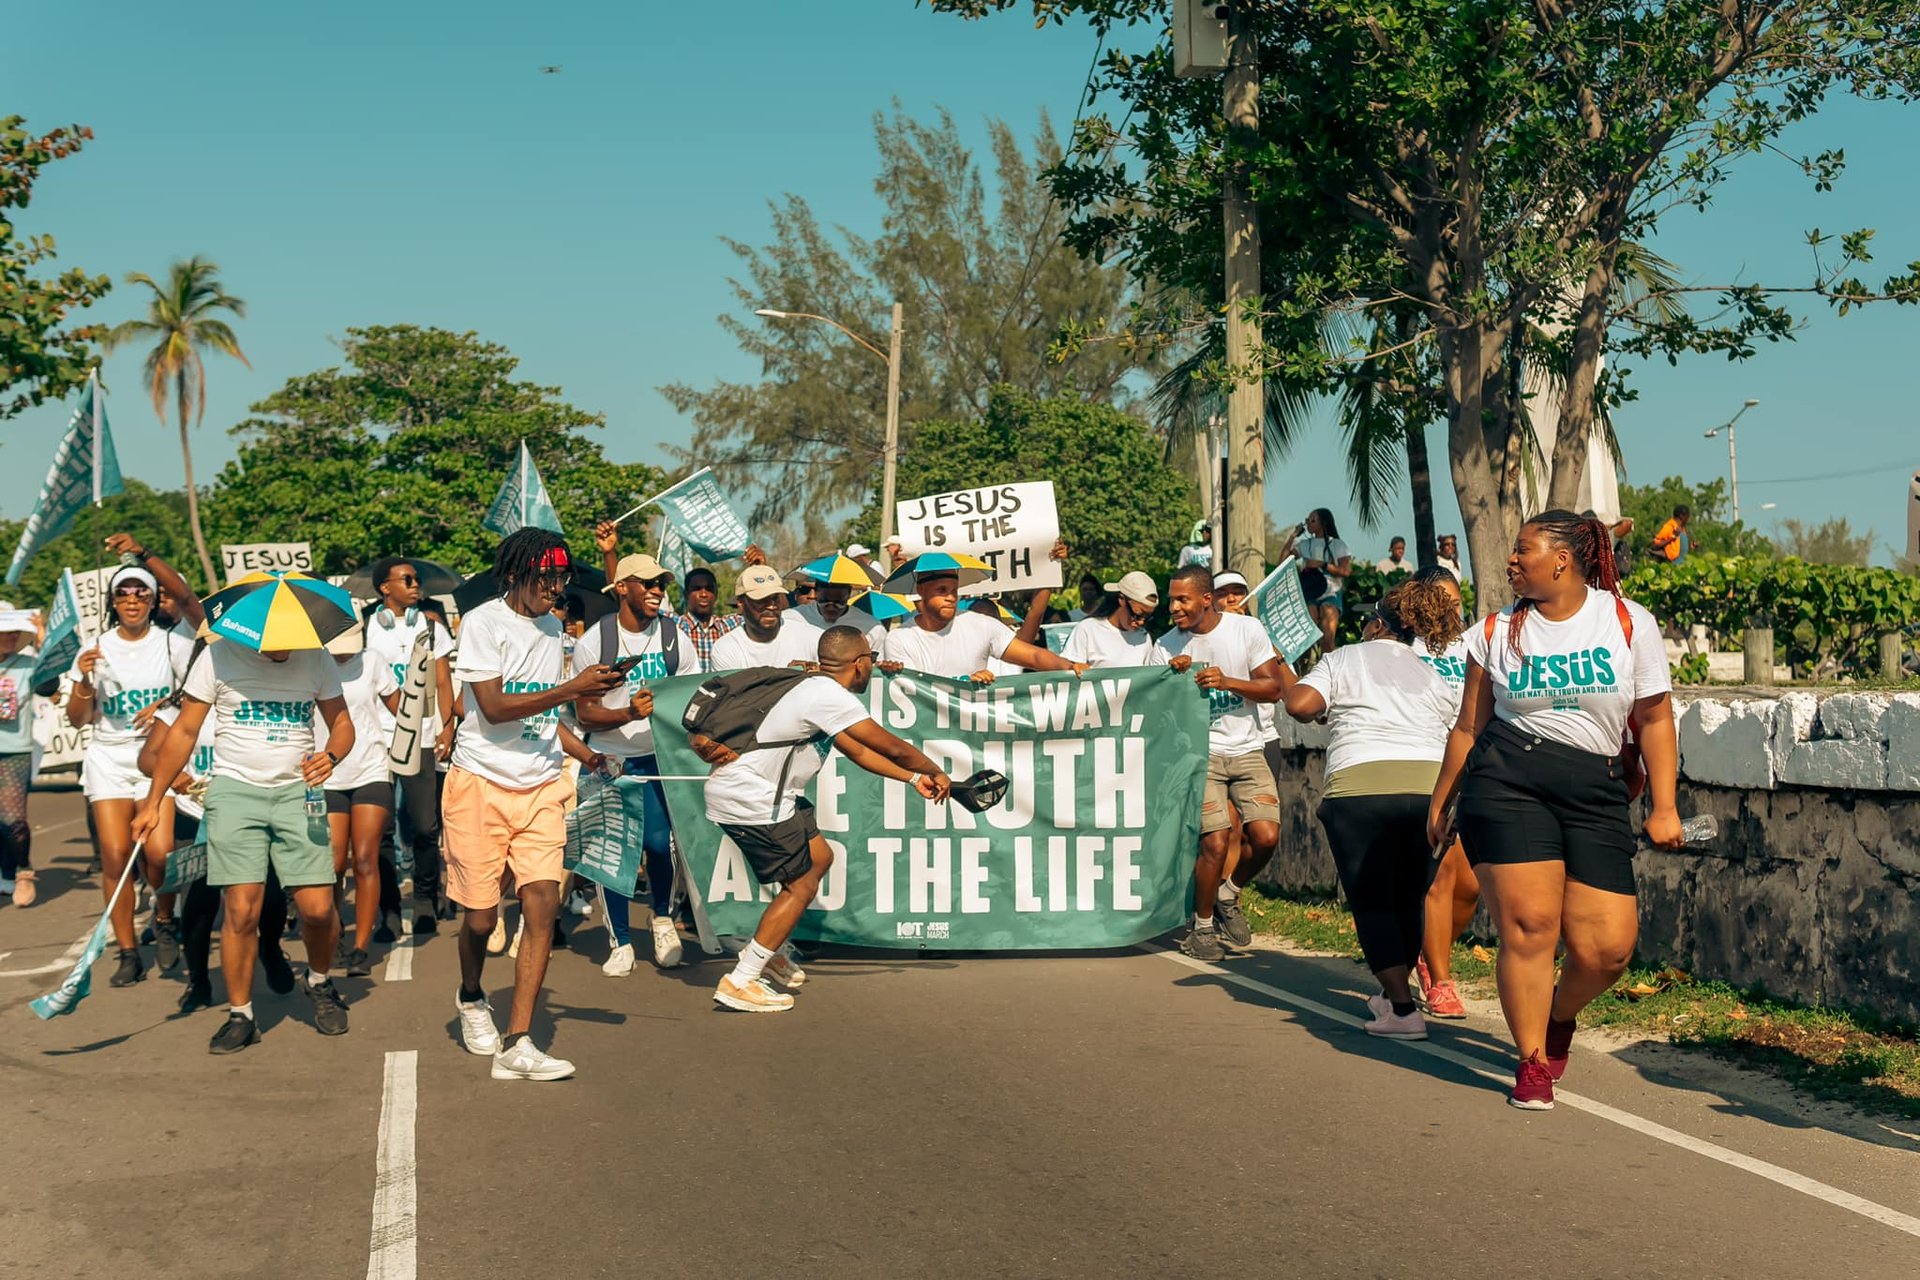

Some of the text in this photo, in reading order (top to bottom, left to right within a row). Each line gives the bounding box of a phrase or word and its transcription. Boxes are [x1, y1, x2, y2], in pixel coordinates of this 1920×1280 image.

[673, 495, 698, 520] AND
[690, 517, 713, 540] THE
[687, 484, 745, 552] THE TRUTH
[908, 487, 1021, 521] JESUS
[924, 514, 1017, 546] IS THE
[225, 550, 310, 570] JESUS
[82, 602, 98, 617] IS
[1276, 574, 1308, 646] THE TRUTH
[221, 618, 261, 641] Bahamas
[1267, 608, 1282, 633] THE
[1275, 629, 1297, 654] LIFE
[626, 652, 667, 680] SUS
[1508, 646, 1616, 691] JESUS
[870, 677, 1144, 733] IS THE WAY,
[1545, 688, 1557, 697] THE
[1559, 687, 1581, 696] TRUTH
[1582, 686, 1596, 694] AND
[233, 700, 314, 723] JESUS
[605, 811, 624, 839] THE
[581, 836, 605, 870] THE
[601, 840, 623, 878] AND
[708, 833, 1142, 914] AD THE LIFE
[926, 922, 949, 931] JESUS
